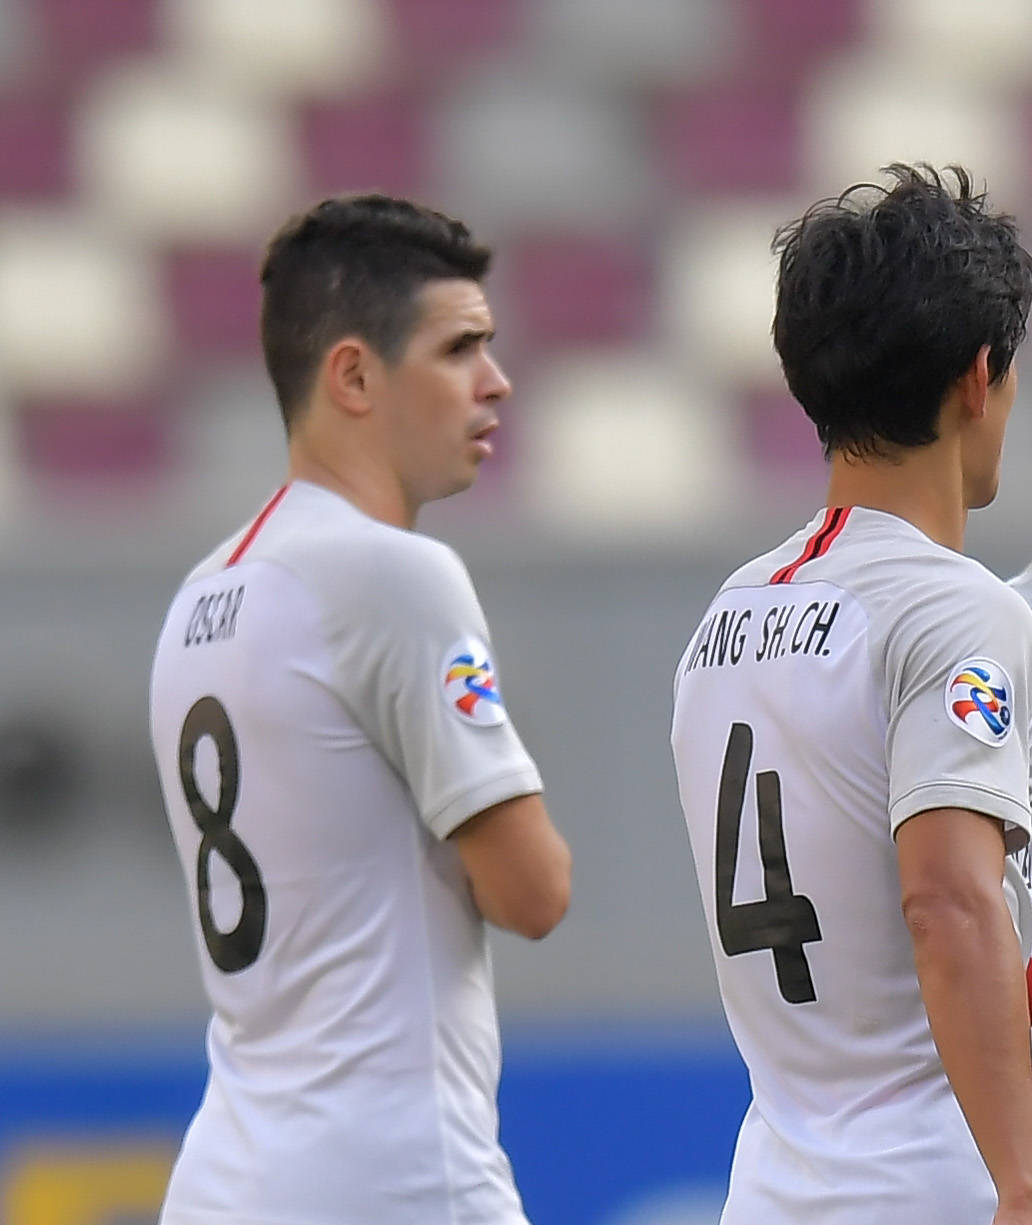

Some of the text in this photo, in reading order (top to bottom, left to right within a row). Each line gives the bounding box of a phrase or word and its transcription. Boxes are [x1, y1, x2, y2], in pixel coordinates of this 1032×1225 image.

[184, 584, 245, 647] OSCAR
[756, 602, 840, 662] SH.CH.
[178, 695, 267, 975] 8
[714, 721, 823, 1004] 4
